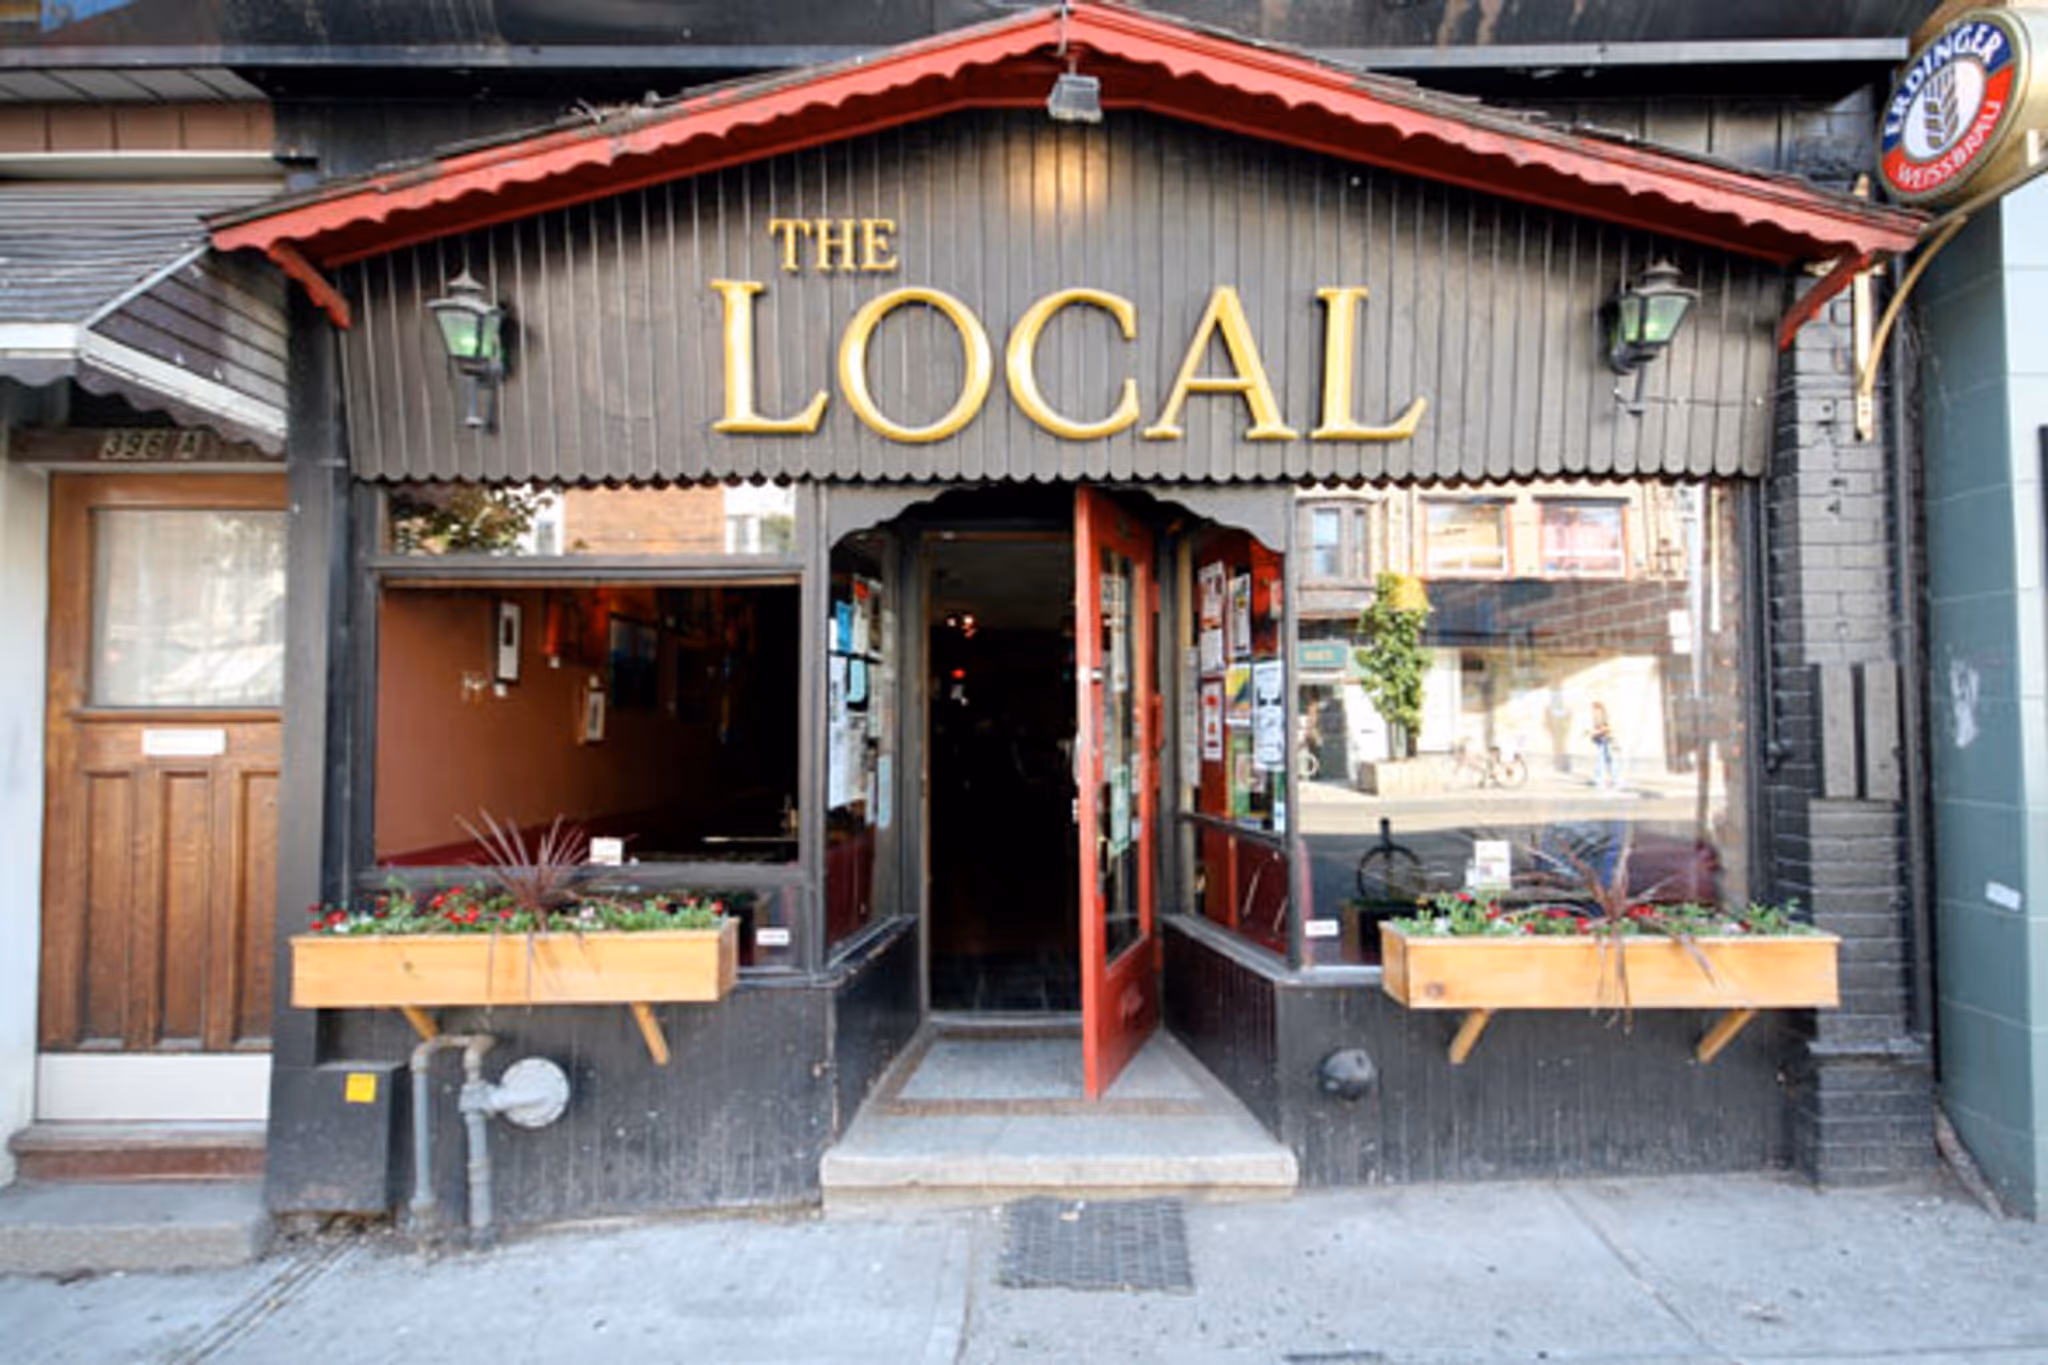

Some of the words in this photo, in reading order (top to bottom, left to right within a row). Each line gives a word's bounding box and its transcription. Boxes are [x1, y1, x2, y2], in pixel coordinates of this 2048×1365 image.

[1885, 23, 2003, 136] ERDINGER
[768, 217, 900, 273] THE
[709, 278, 1428, 443] LOCAL
